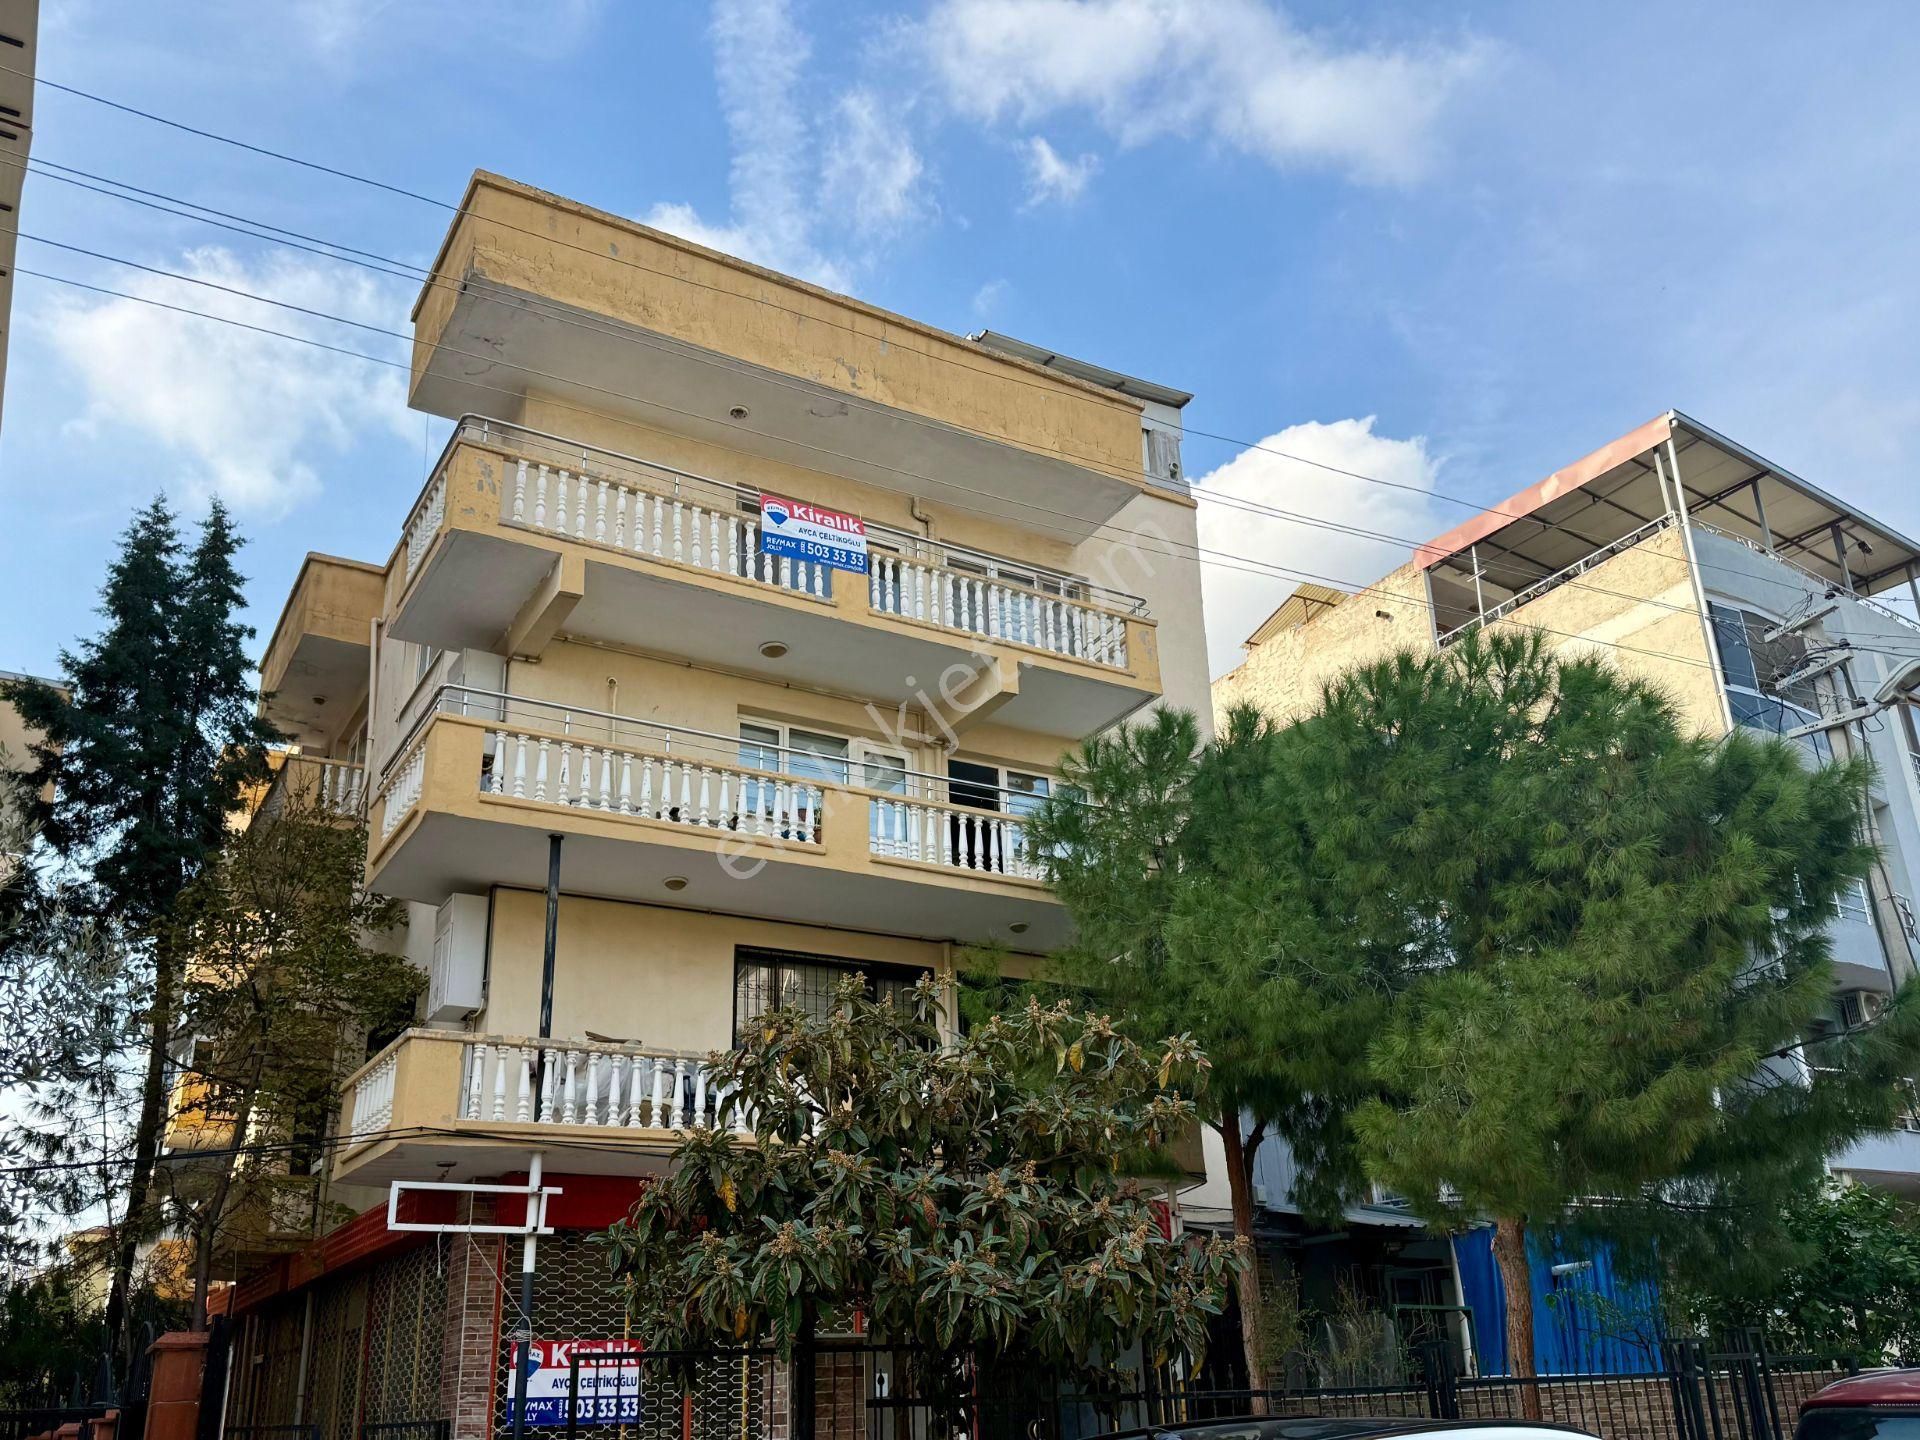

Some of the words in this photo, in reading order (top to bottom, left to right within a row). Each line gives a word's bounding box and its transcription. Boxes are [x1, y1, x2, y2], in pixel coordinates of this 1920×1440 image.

[793, 505, 861, 534] Kiralık
[766, 536, 796, 549] RE/MAX
[798, 527, 817, 538] AYÇA
[819, 531, 861, 547] ÇELTİKOĞLU
[766, 544, 783, 552] JOLLY
[807, 542, 830, 559] 503
[832, 549, 847, 563] 33
[850, 552, 864, 567] 33
[552, 1378, 574, 1390] AYÇ
[580, 1374, 638, 1390] ÇELTİKOĞLU
[598, 1398, 616, 1418] 33
[620, 1398, 639, 1417] 33
